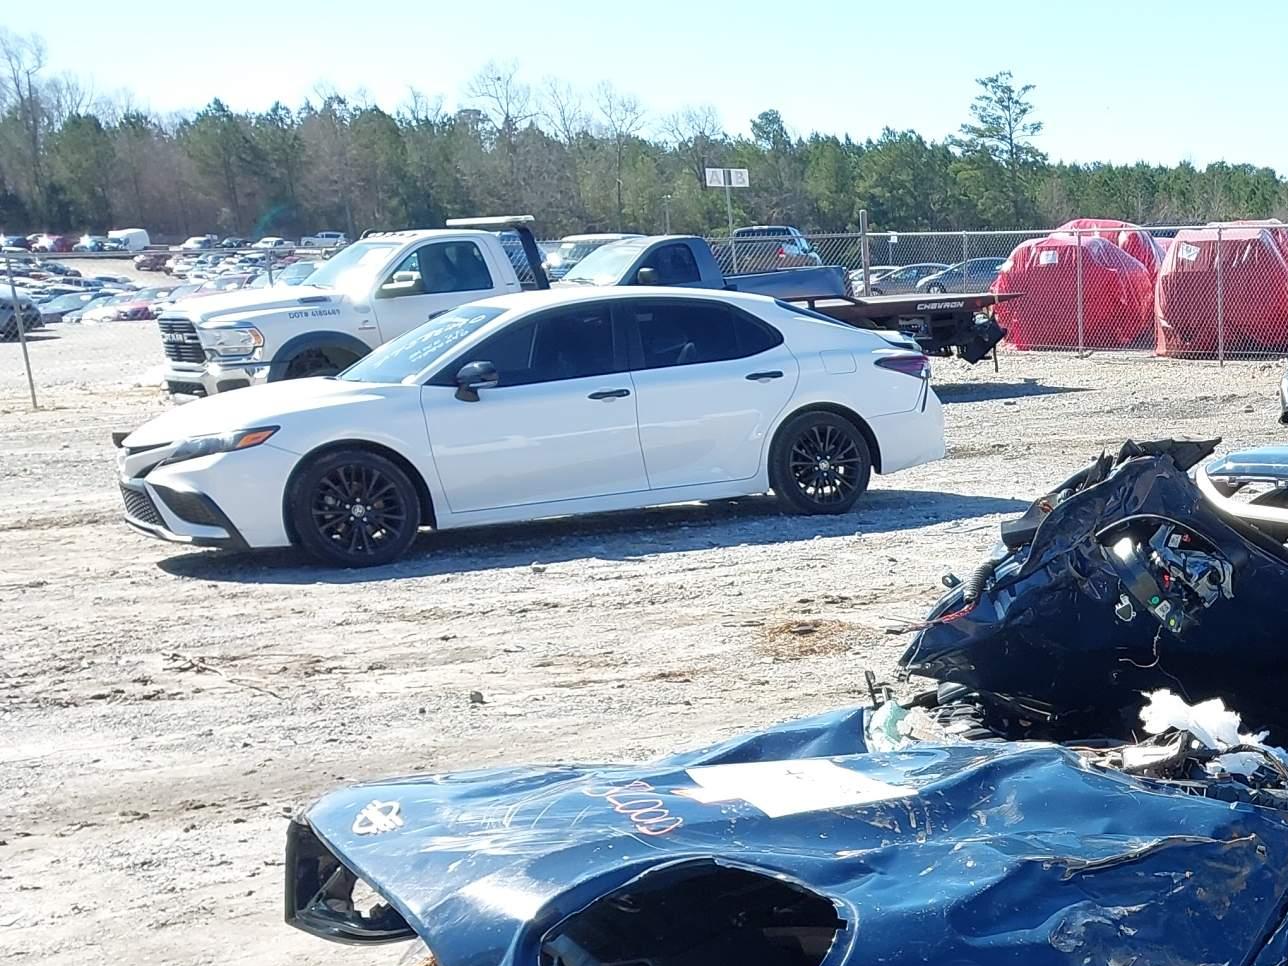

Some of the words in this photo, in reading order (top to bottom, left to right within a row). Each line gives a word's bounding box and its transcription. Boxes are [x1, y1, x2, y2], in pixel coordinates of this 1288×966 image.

[709, 170, 722, 185] A
[735, 170, 746, 185] B
[916, 301, 965, 311] CHEVRON
